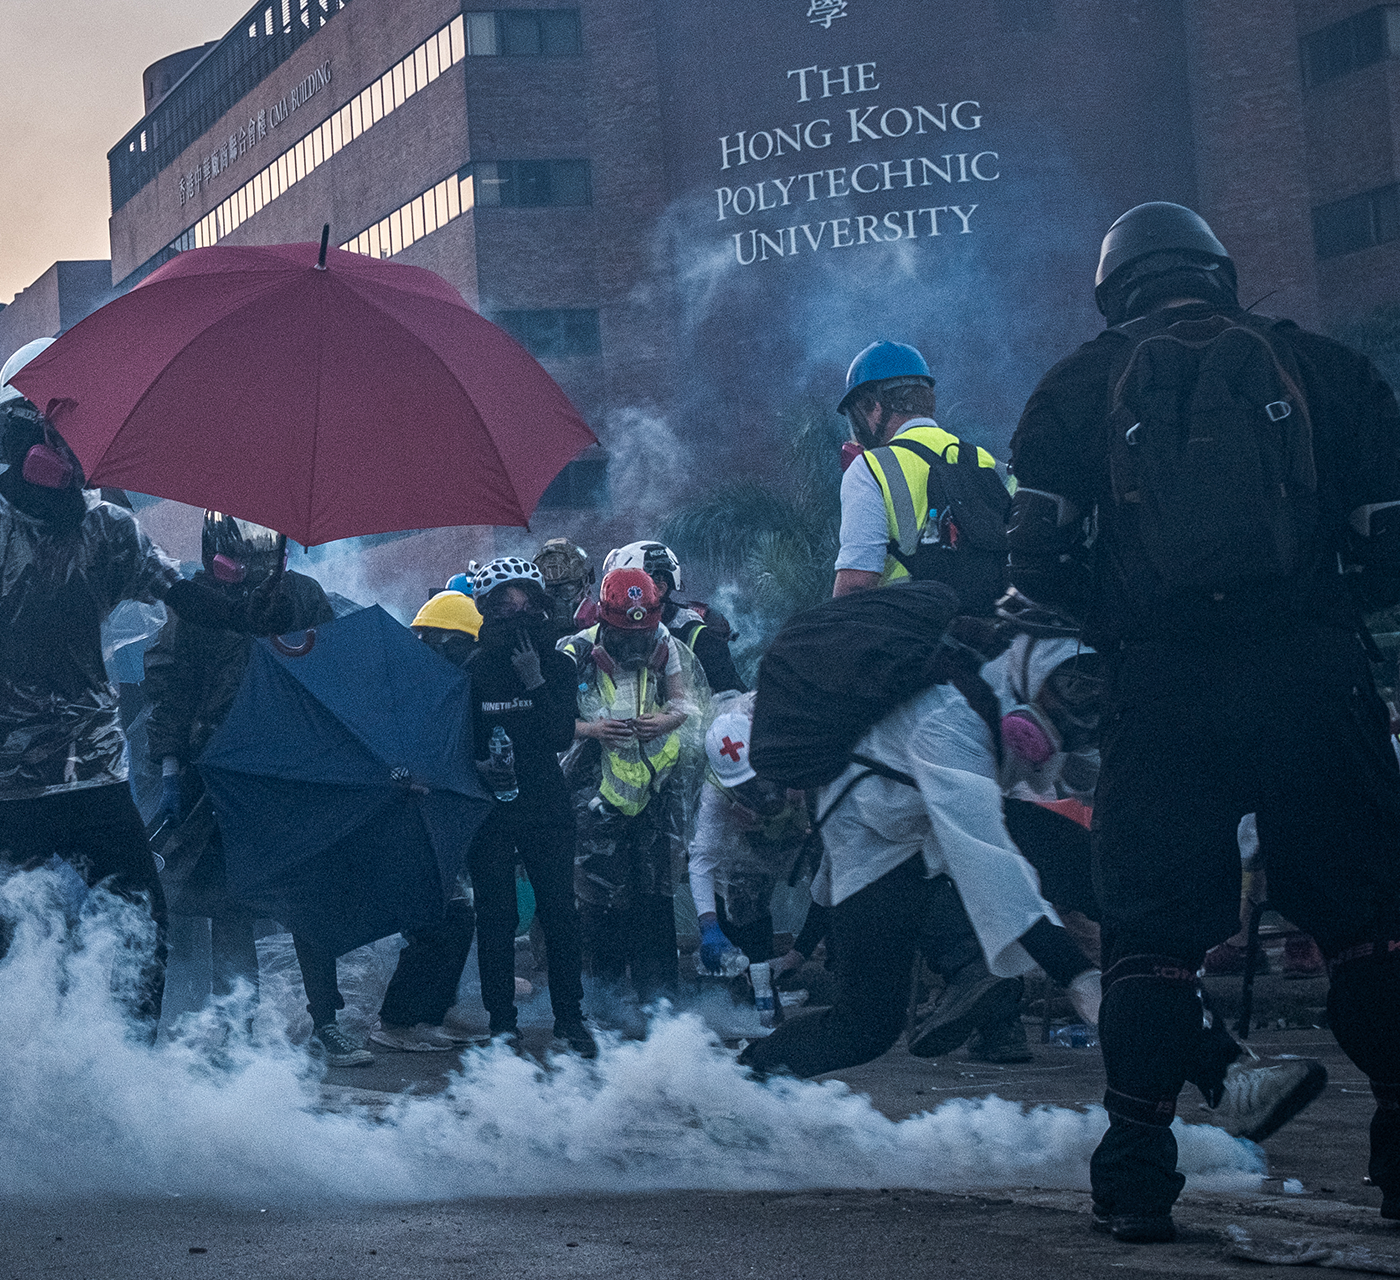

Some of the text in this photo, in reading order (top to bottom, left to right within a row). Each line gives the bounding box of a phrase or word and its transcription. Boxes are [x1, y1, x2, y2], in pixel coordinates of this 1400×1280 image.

[806, 0, 848, 29] 學
[269, 60, 332, 129] CMA BUILDING
[787, 61, 880, 103] THE
[719, 100, 982, 170] HONG KONG
[715, 151, 1000, 221] POLYTECHNIC
[733, 204, 979, 266] UNIVERSITY
